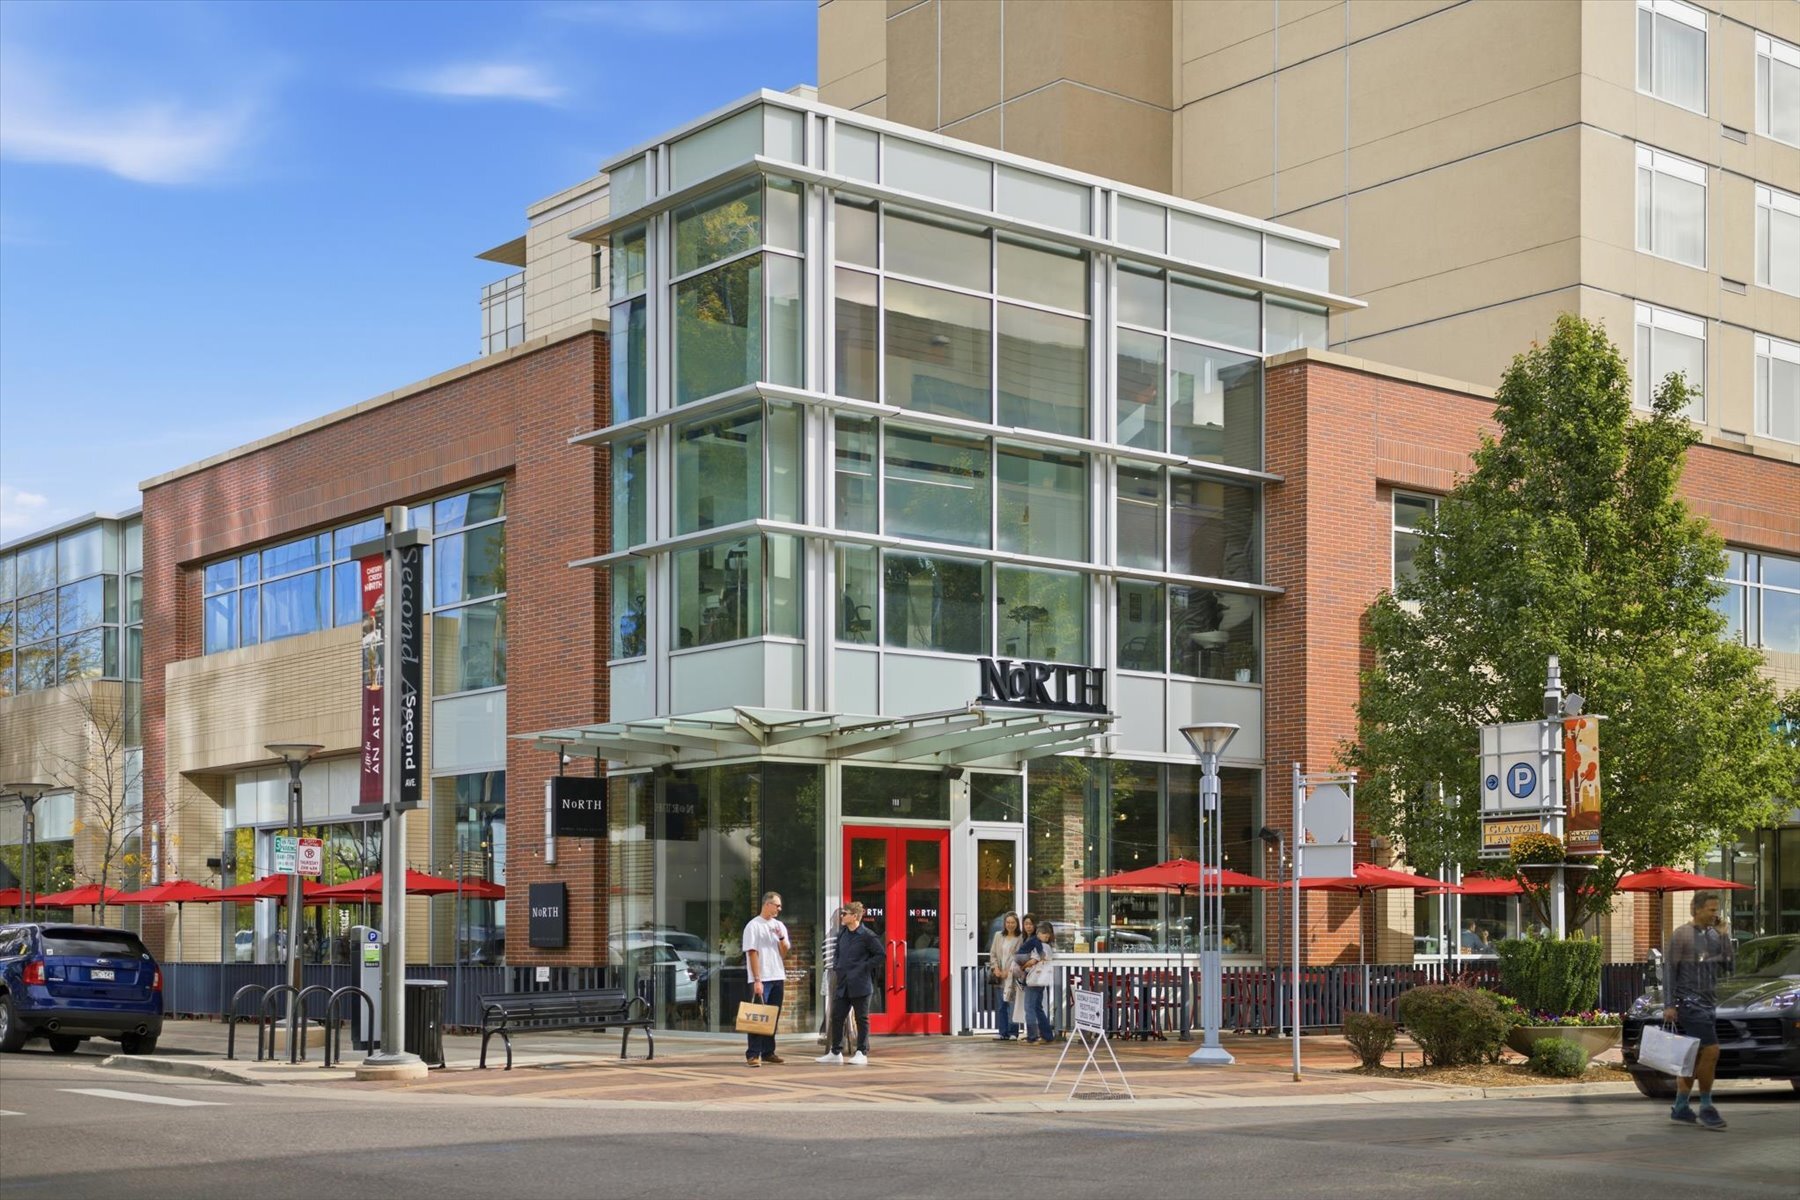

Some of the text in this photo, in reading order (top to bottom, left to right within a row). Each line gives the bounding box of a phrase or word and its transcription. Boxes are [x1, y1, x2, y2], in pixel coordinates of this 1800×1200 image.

[364, 581, 383, 592] NORTH
[401, 548, 418, 664] Second
[405, 695, 417, 770] Second
[372, 705, 381, 774] AN ART
[1489, 823, 1538, 834] CLAYTON
[1489, 835, 1513, 845] LAN
[745, 1012, 769, 1022] YETI
